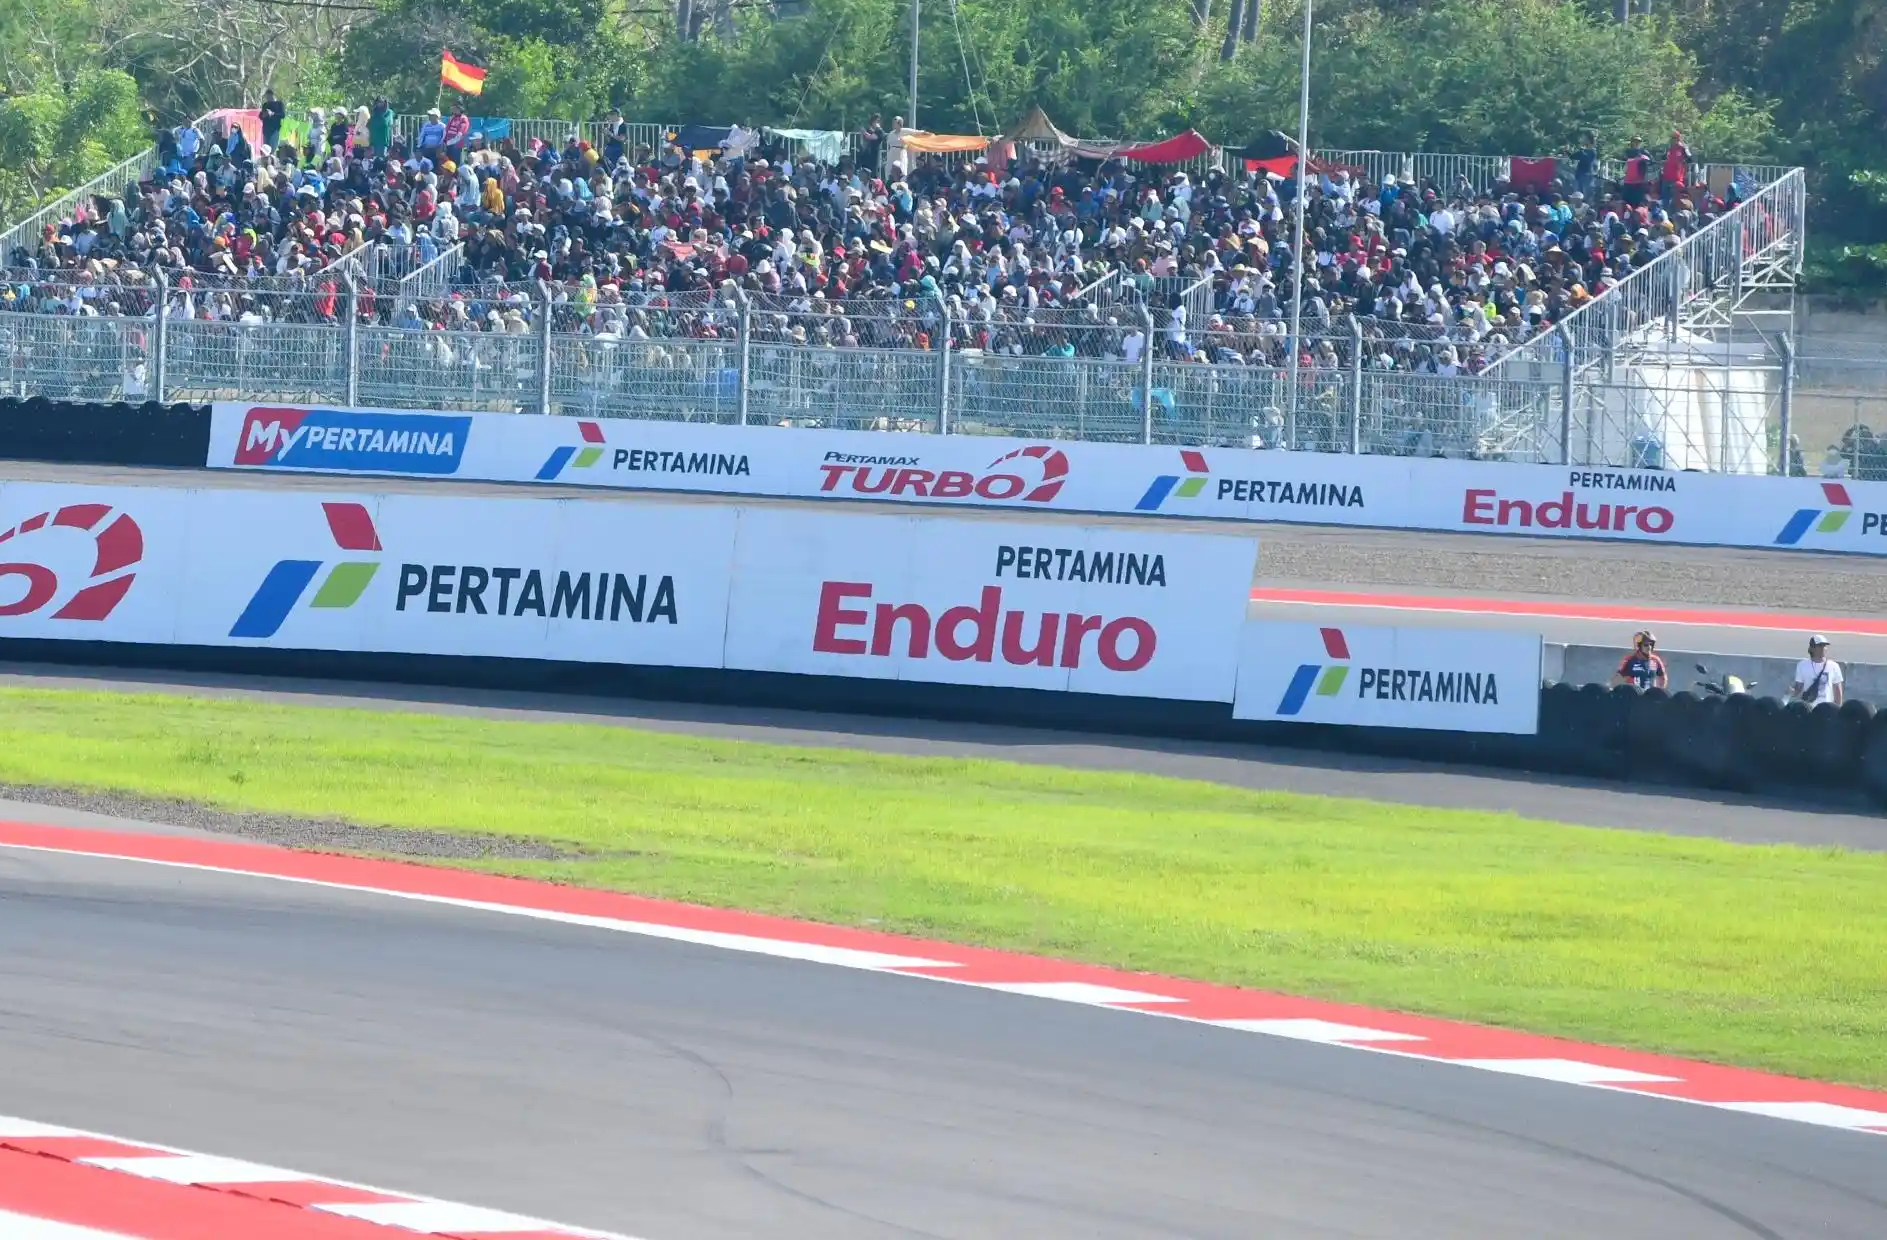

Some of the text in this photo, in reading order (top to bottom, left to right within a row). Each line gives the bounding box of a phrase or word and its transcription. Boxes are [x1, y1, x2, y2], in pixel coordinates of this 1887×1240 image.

[613, 448, 750, 476] PERTAMINA
[820, 451, 920, 466] PERTAMAX
[819, 464, 1025, 501] TURBO
[1217, 479, 1365, 507] PERTAMINA
[1570, 471, 1676, 493] PERTAMINA
[1462, 489, 1674, 533] Enduro
[996, 545, 1167, 587] PERTAMINA
[395, 563, 678, 625] PERTAMINA
[813, 581, 1157, 672] Enduro
[1358, 667, 1499, 705] PERTAMINA
